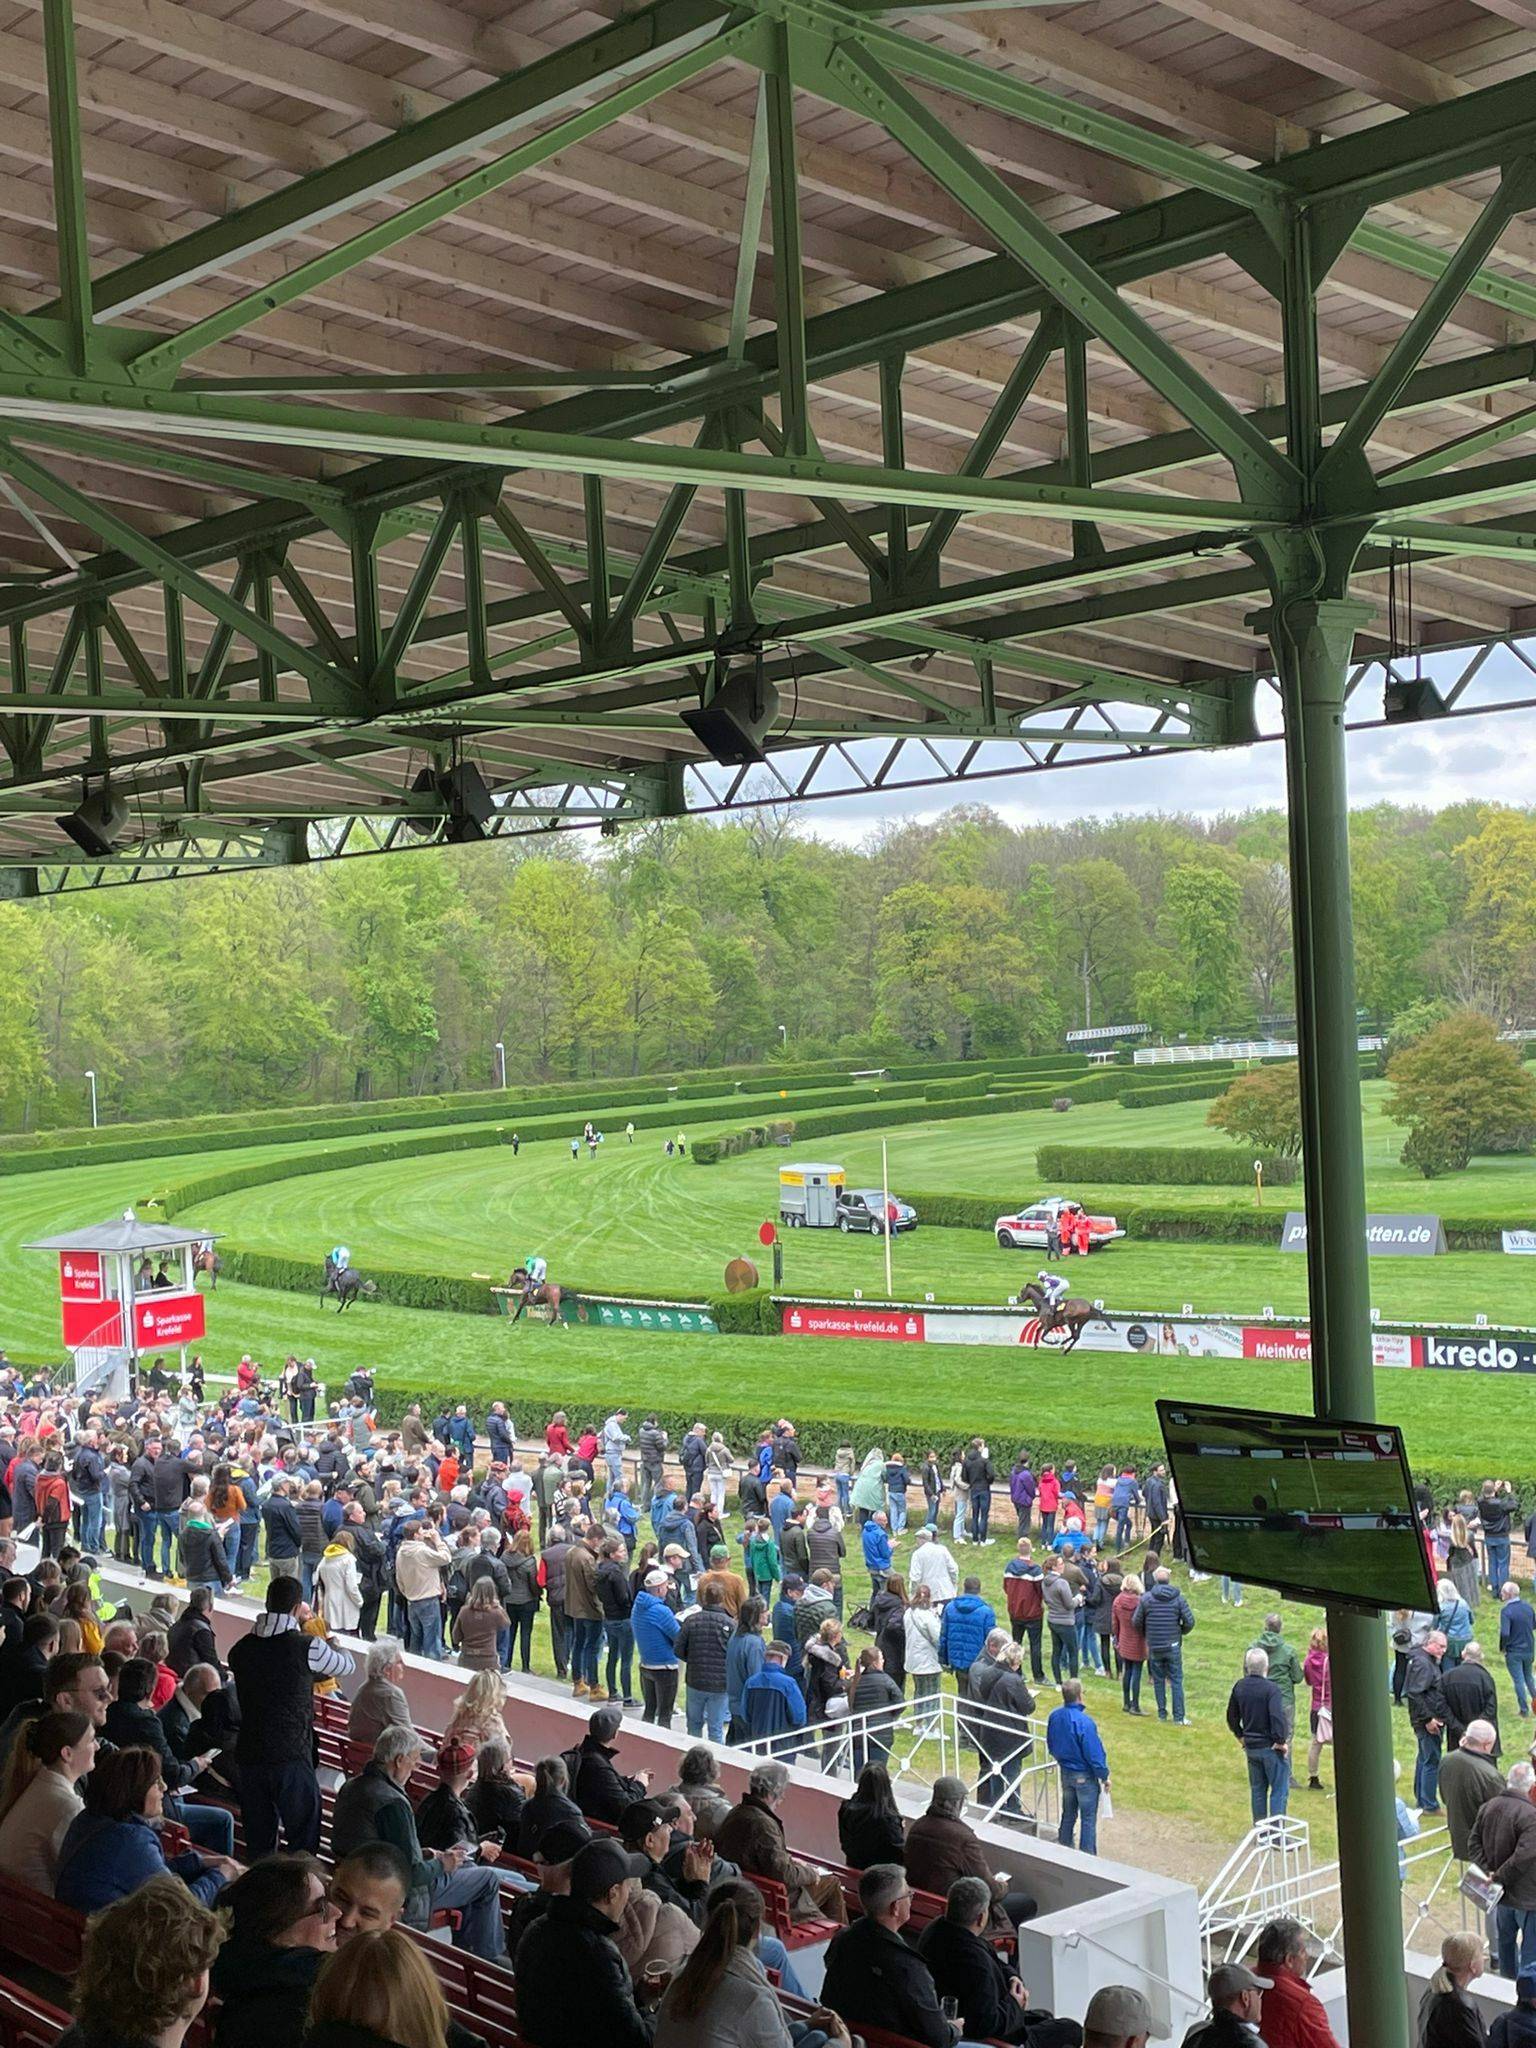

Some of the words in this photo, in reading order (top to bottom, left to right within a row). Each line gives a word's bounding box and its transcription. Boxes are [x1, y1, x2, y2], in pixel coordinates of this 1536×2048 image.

[74, 1280, 96, 1290] Krefeld
[156, 1313, 192, 1326] Sparkasse
[808, 1318, 899, 1334] sparkasse-krefeld.de
[156, 1325, 183, 1337] Krefeld
[1427, 1337, 1518, 1369] kredo
